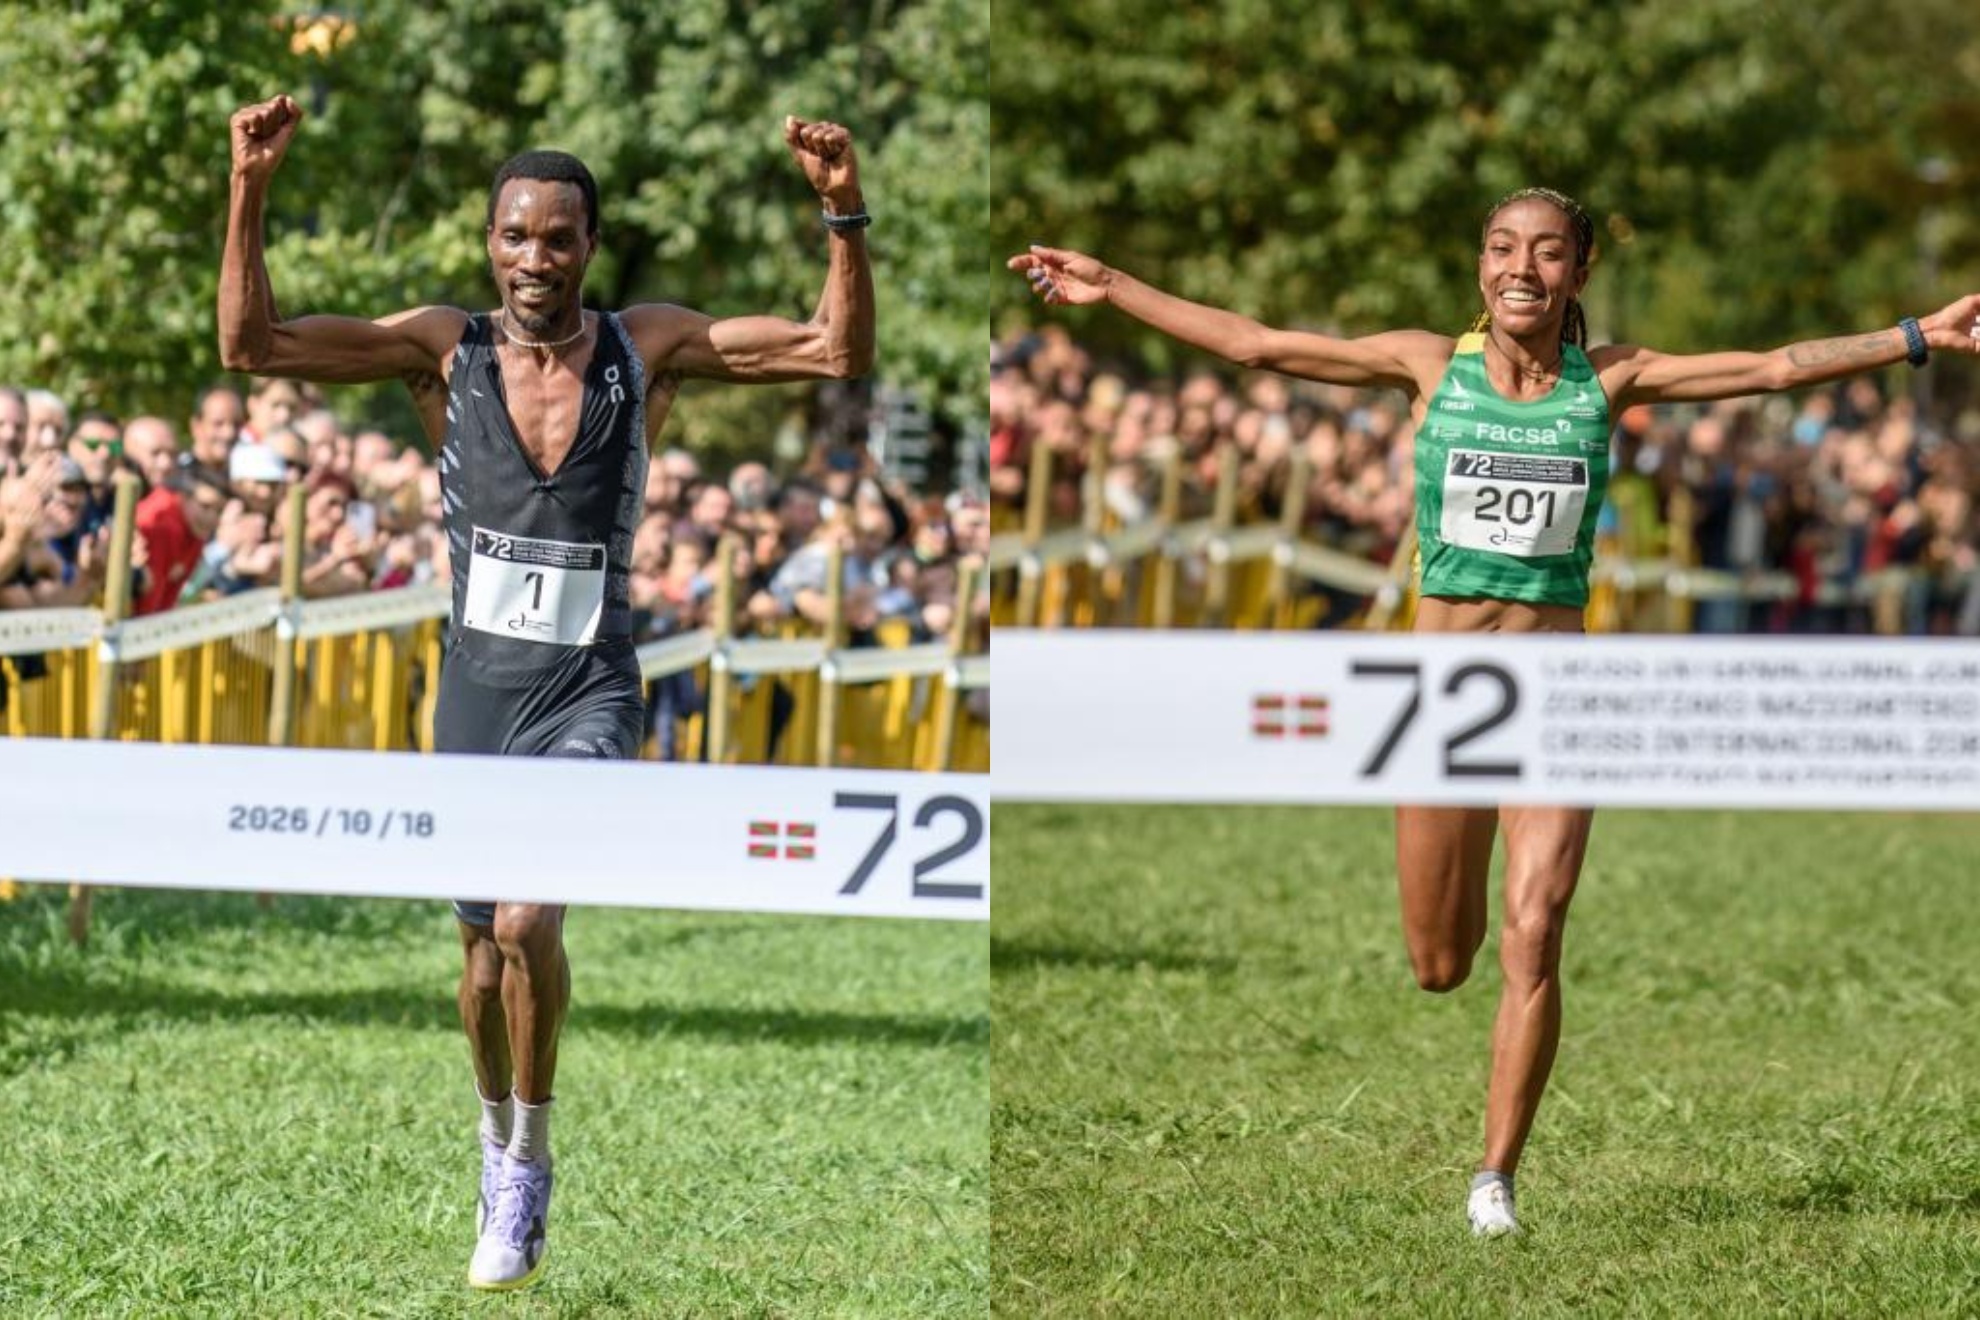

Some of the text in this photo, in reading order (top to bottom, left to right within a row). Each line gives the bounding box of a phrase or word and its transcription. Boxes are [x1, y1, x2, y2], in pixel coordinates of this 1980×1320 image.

[1464, 453, 1492, 476] 72
[1474, 486, 1556, 528] 201
[486, 534, 512, 560] 72
[525, 571, 544, 611] 1
[1349, 660, 1523, 778] 72
[833, 791, 983, 899] 72
